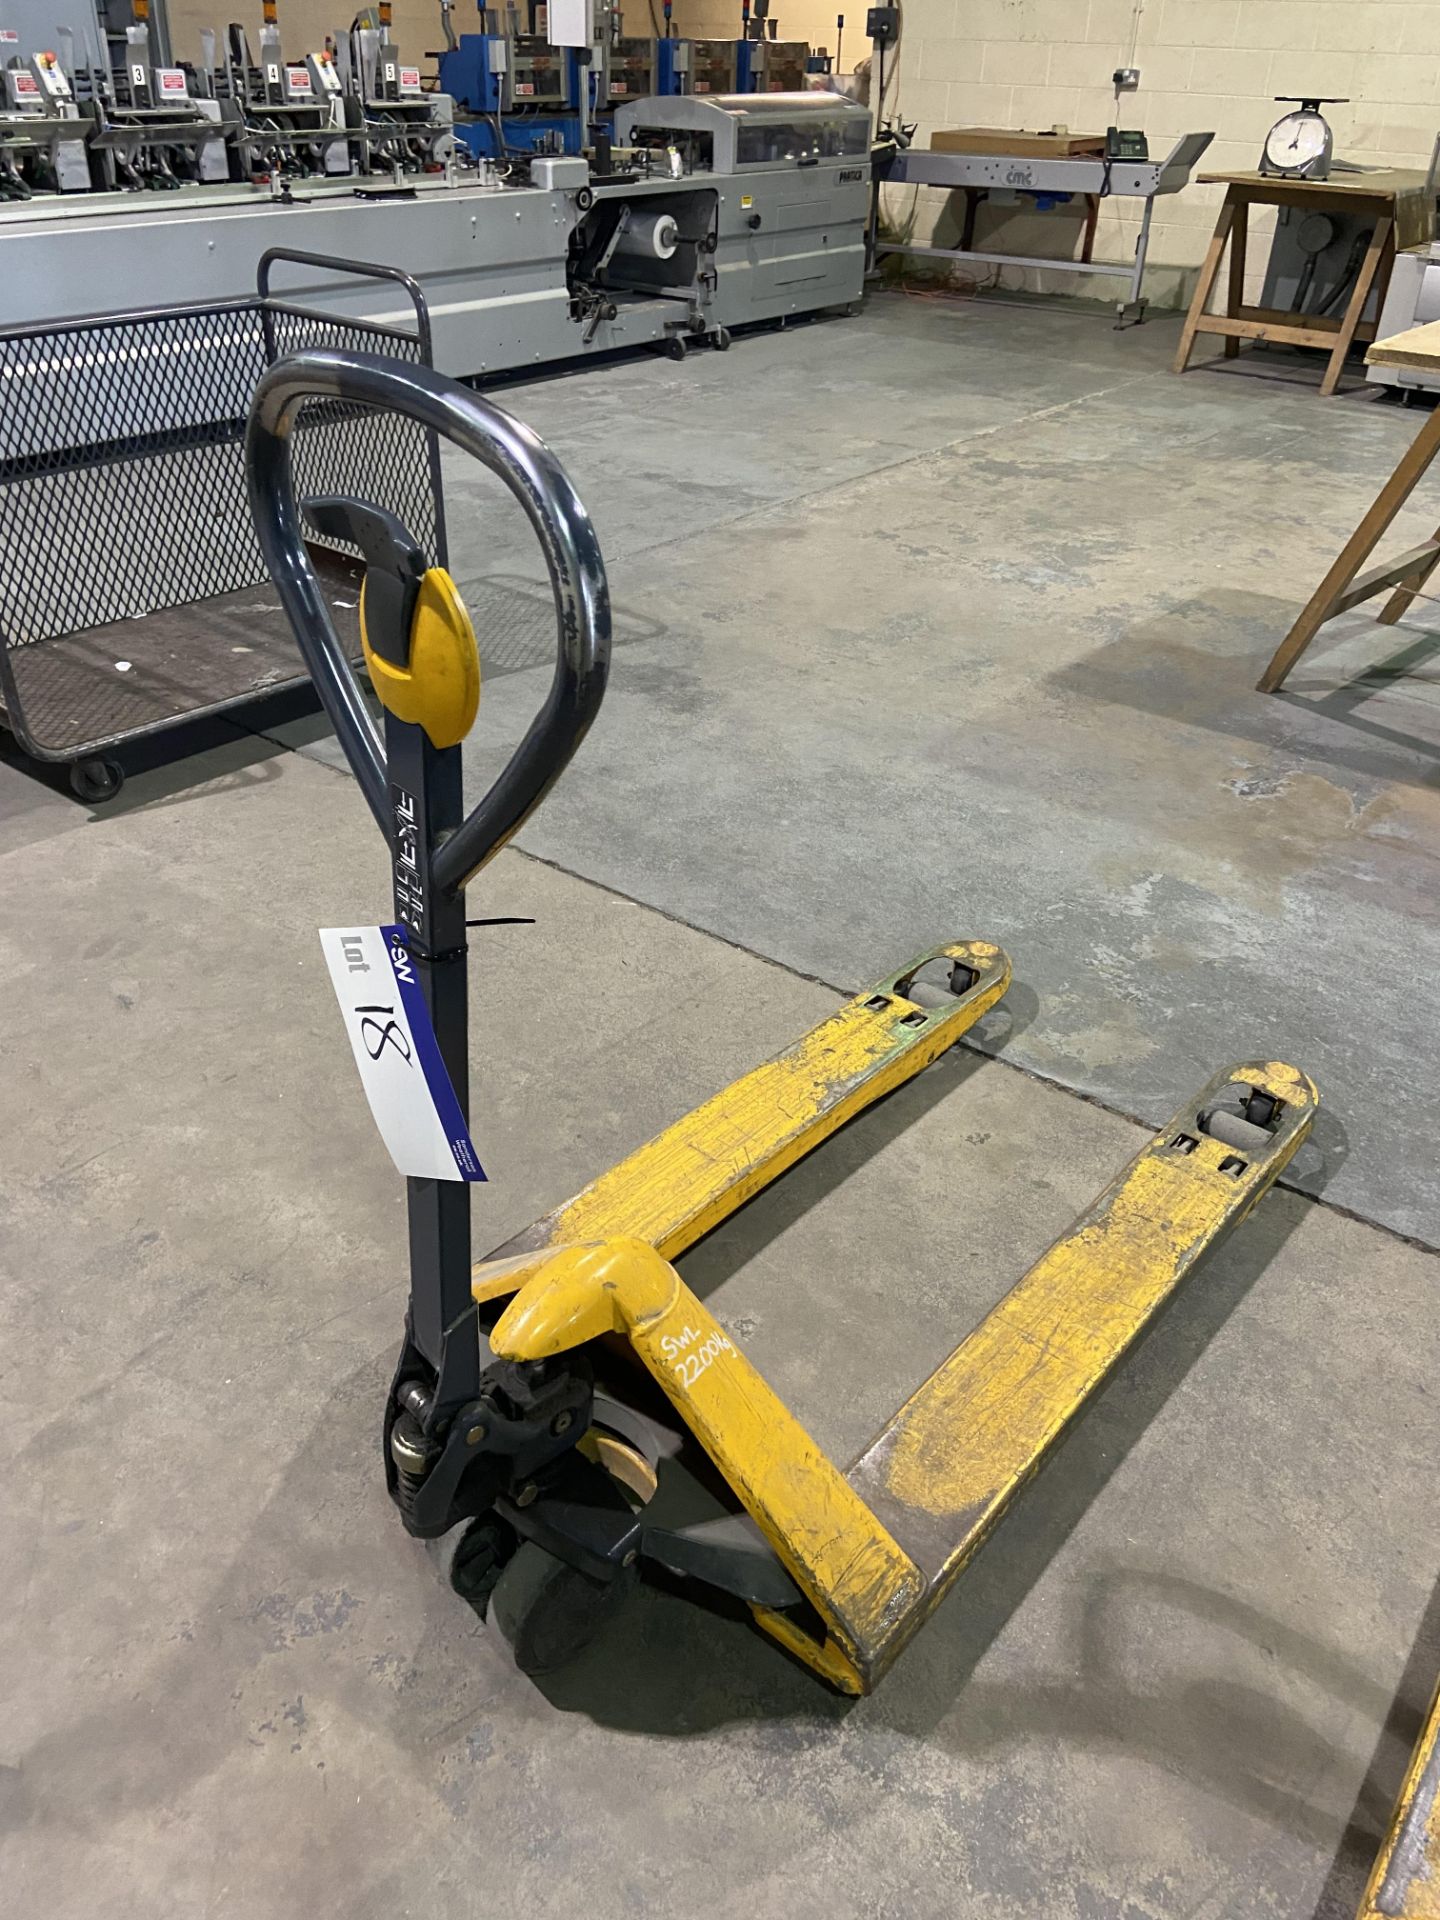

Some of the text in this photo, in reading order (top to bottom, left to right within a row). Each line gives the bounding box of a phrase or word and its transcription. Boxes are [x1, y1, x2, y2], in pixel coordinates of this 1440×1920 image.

[134, 67, 143, 82] 3
[340, 935, 371, 974] Lot
[354, 1005, 413, 1068] 18
[660, 1326, 701, 1360] SWL
